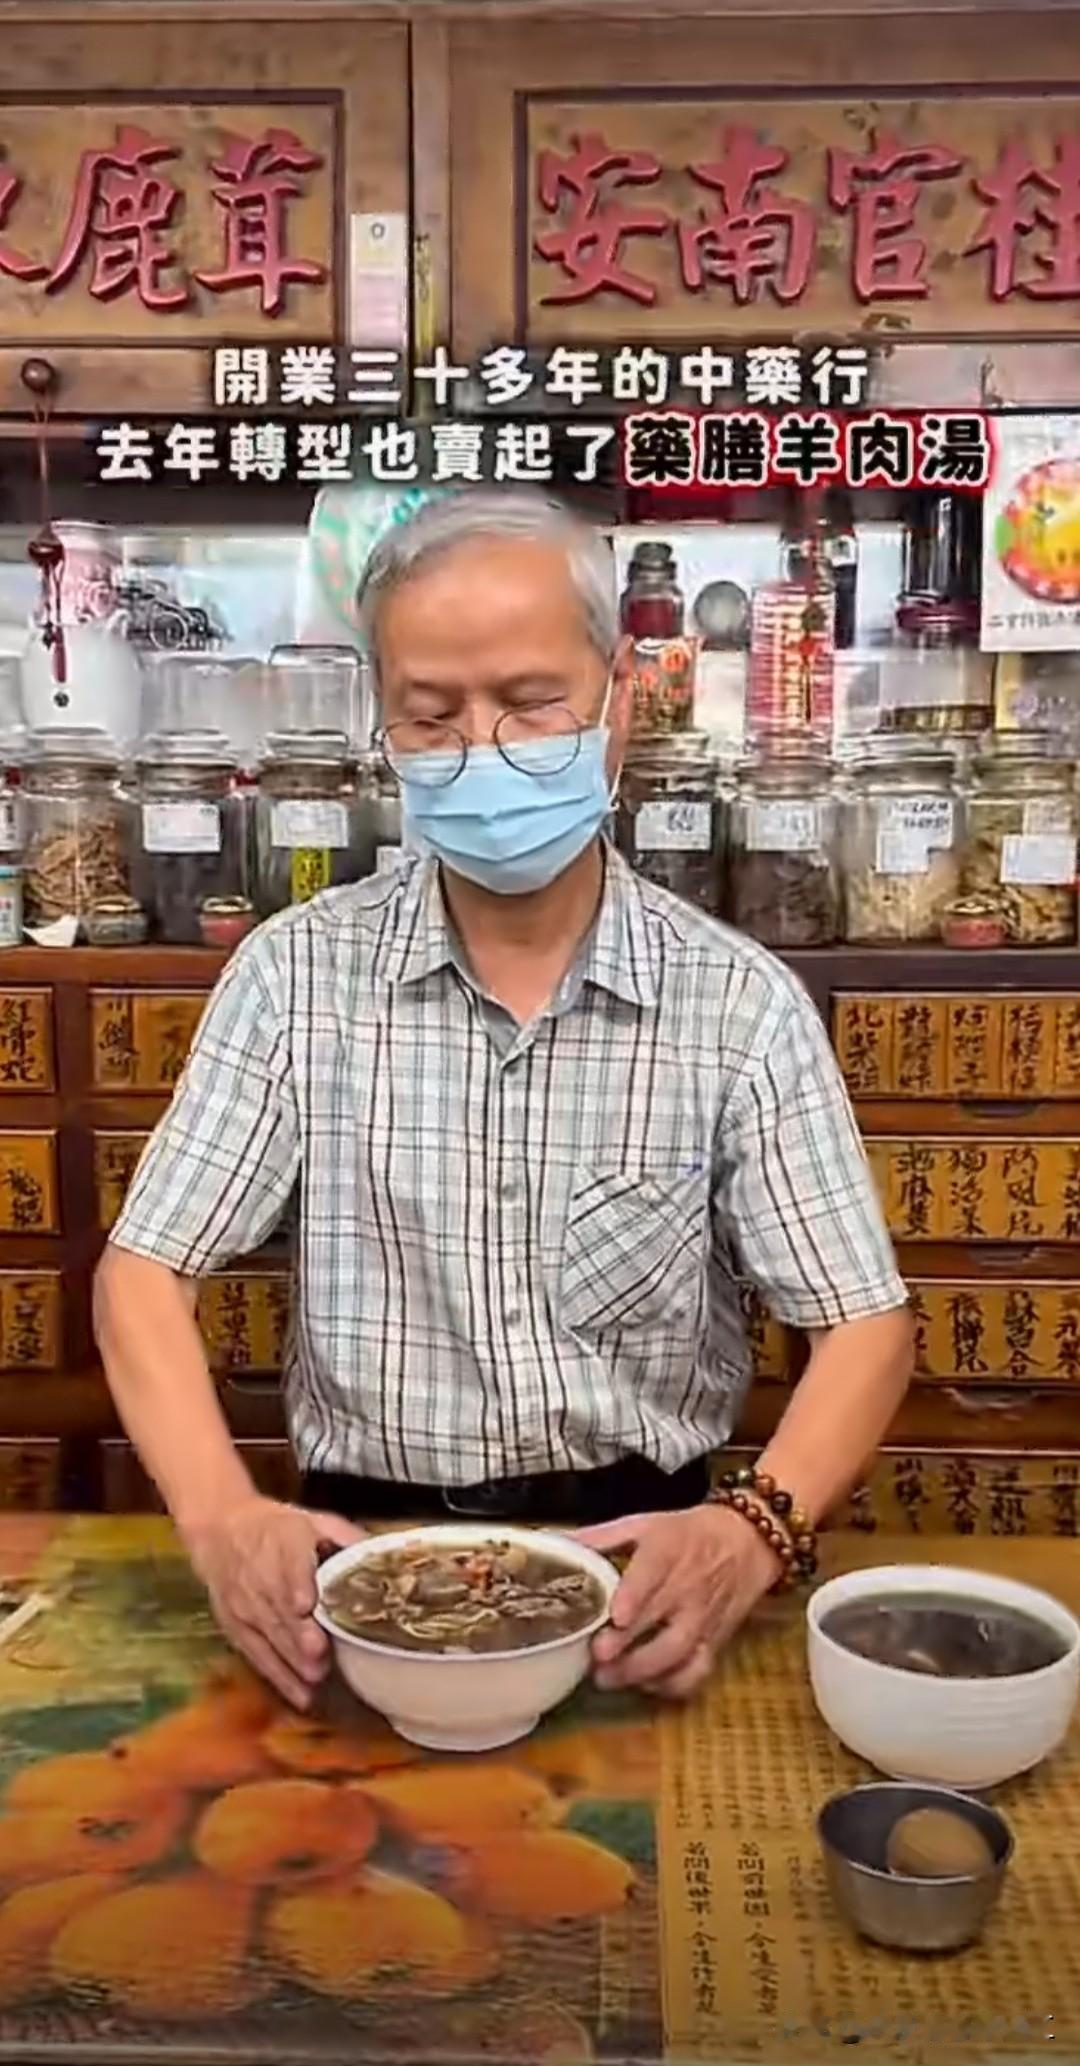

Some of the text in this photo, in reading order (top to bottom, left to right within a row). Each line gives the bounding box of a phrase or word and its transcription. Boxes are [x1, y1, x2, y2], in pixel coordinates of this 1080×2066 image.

[0, 124, 328, 318] 鹿茸
[533, 122, 1080, 307] 安南官桂
